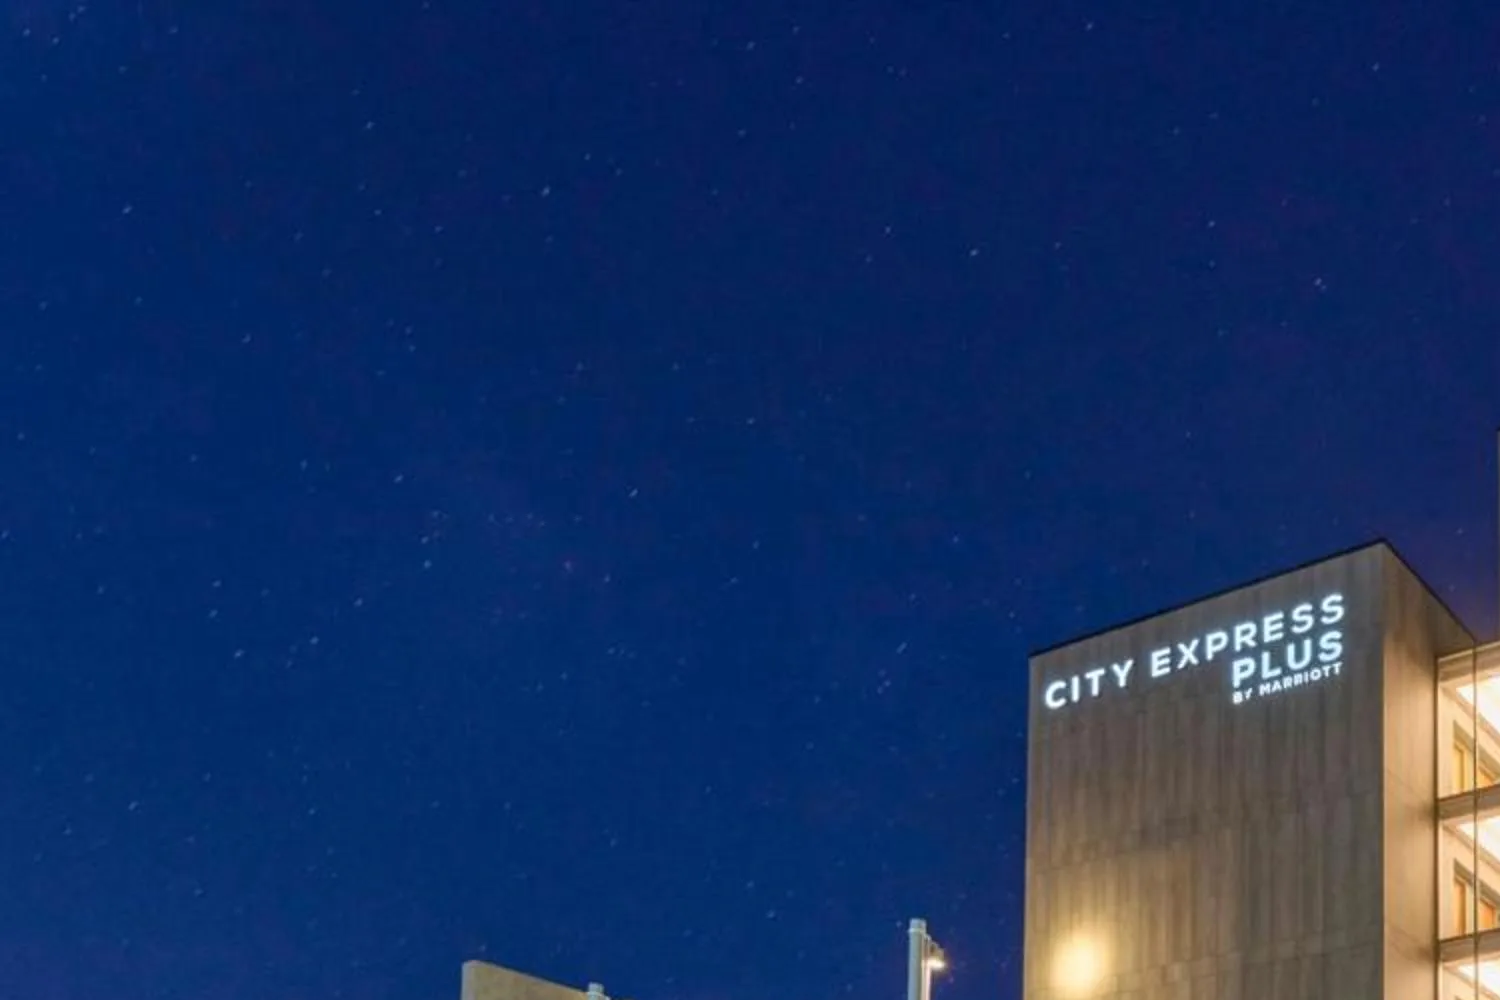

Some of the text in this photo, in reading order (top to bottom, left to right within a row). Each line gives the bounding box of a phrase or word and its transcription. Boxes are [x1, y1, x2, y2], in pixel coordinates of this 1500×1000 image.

[1045, 594, 1345, 709] CITY EXPRESS
[1231, 631, 1343, 688] PLUS
[1232, 661, 1343, 704] BY MARRIOTT
